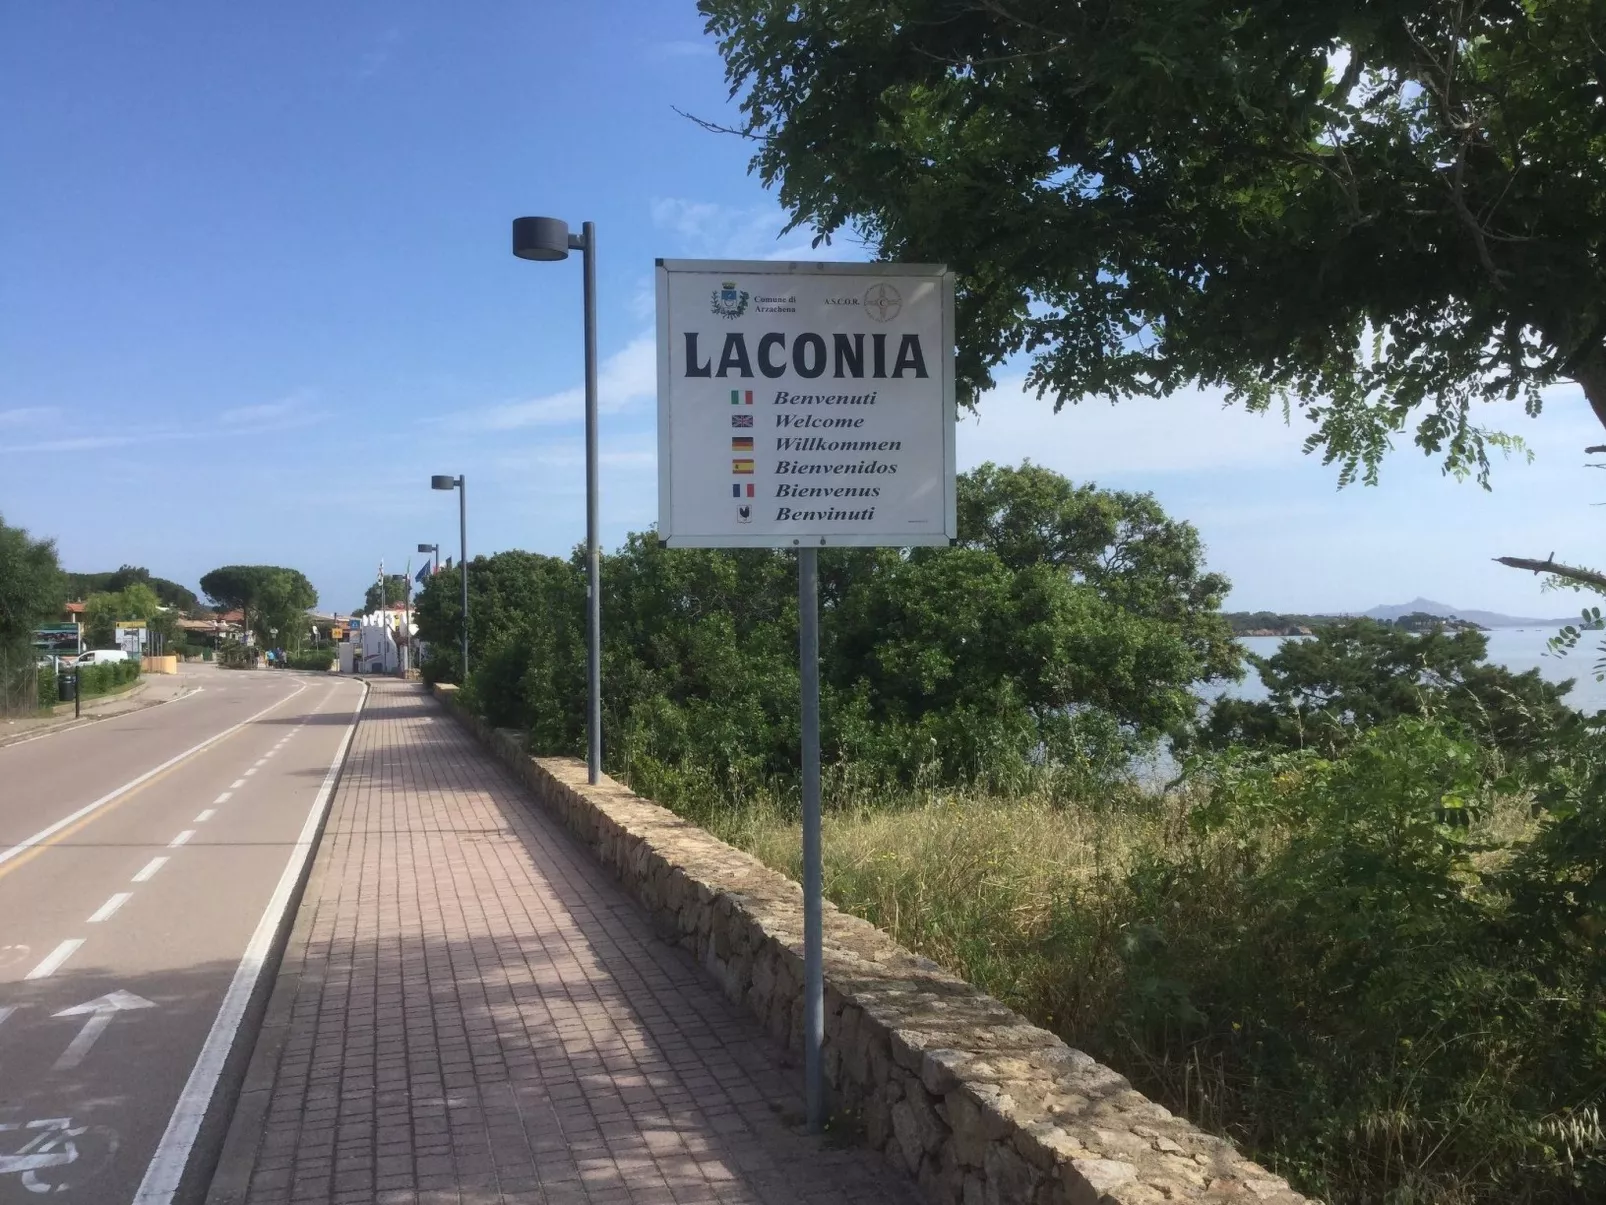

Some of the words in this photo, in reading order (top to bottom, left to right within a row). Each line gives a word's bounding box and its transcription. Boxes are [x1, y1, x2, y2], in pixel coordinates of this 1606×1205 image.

[754, 295, 786, 304] Comune
[788, 295, 797, 304] di
[754, 305, 796, 314] Arzachena
[684, 332, 929, 379] LACONIA
[772, 390, 877, 405] Benvenuti
[774, 414, 865, 428] Welcome
[775, 436, 902, 451] Willkommen
[774, 460, 898, 474] Bienvenidos
[775, 483, 881, 498] Bienvenus
[775, 506, 875, 521] Benvinuti
